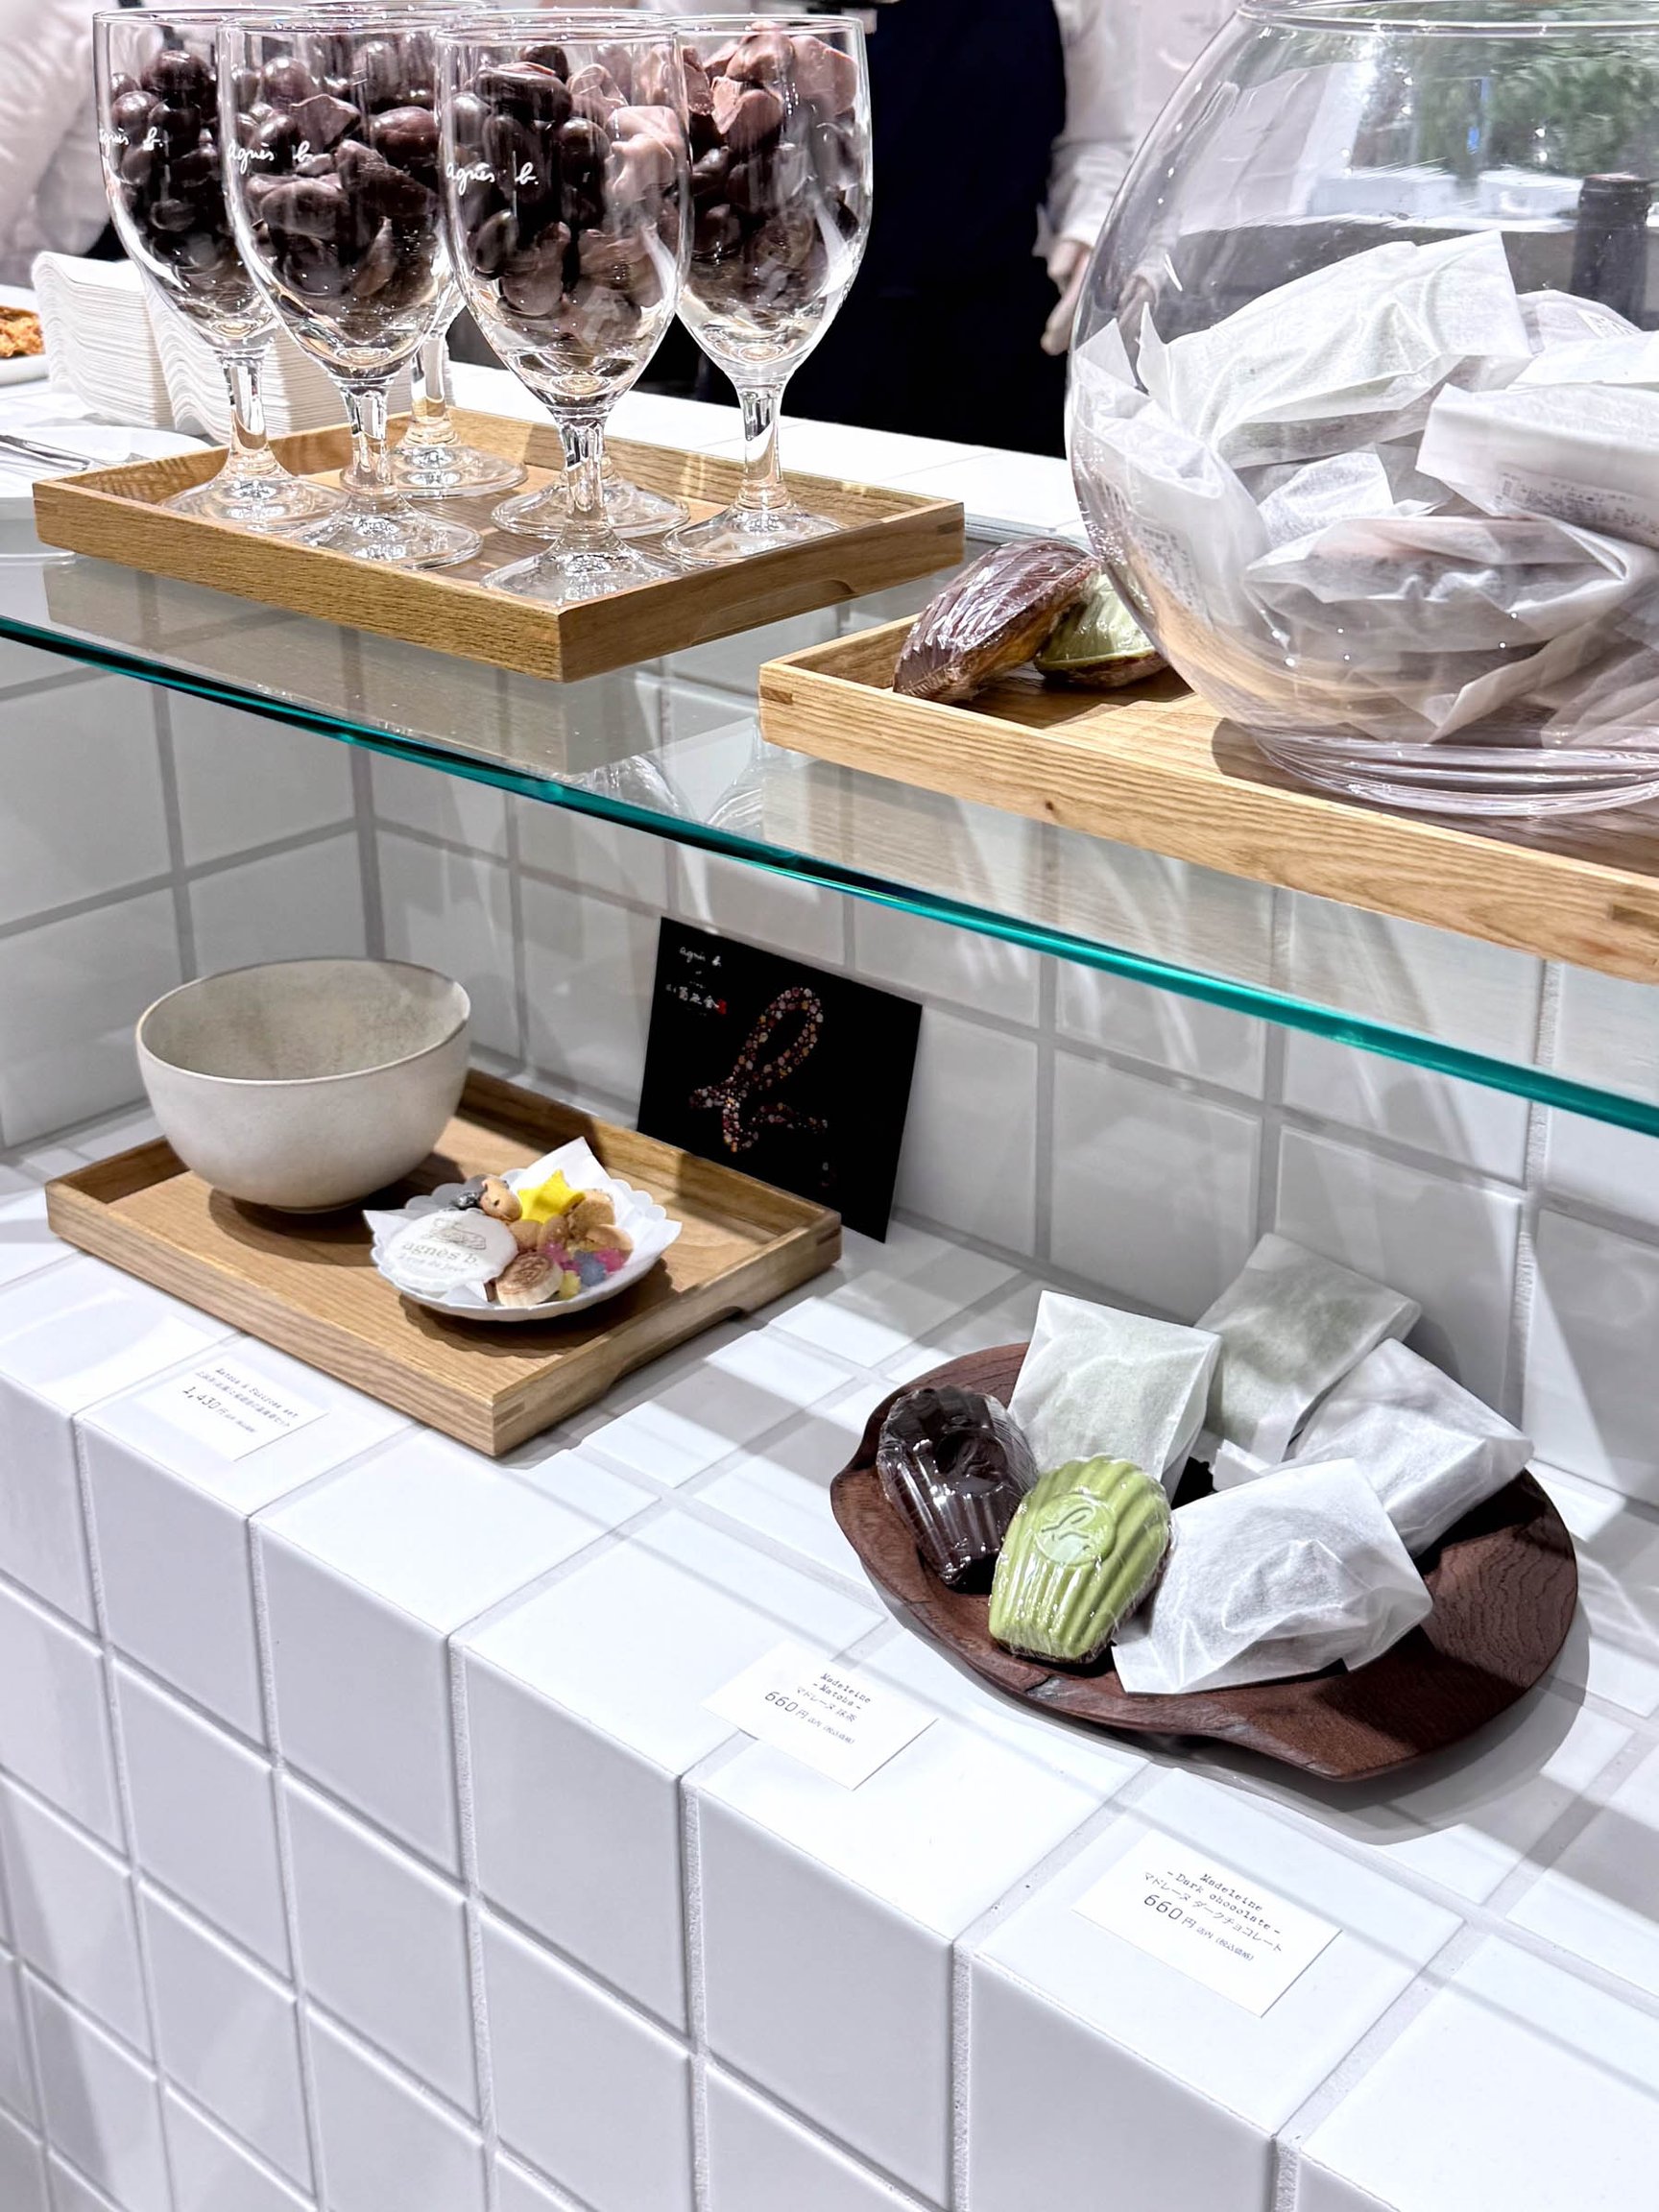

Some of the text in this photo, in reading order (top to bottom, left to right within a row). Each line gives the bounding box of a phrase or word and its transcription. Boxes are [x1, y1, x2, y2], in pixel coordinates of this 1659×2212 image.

[446, 161, 539, 196] agnès b.
[820, 1672, 872, 1704] Madeleine
[1199, 1873, 1263, 1911] Madeleine
[1142, 1871, 1283, 1953] マドレーヌ ダークチョコレート
